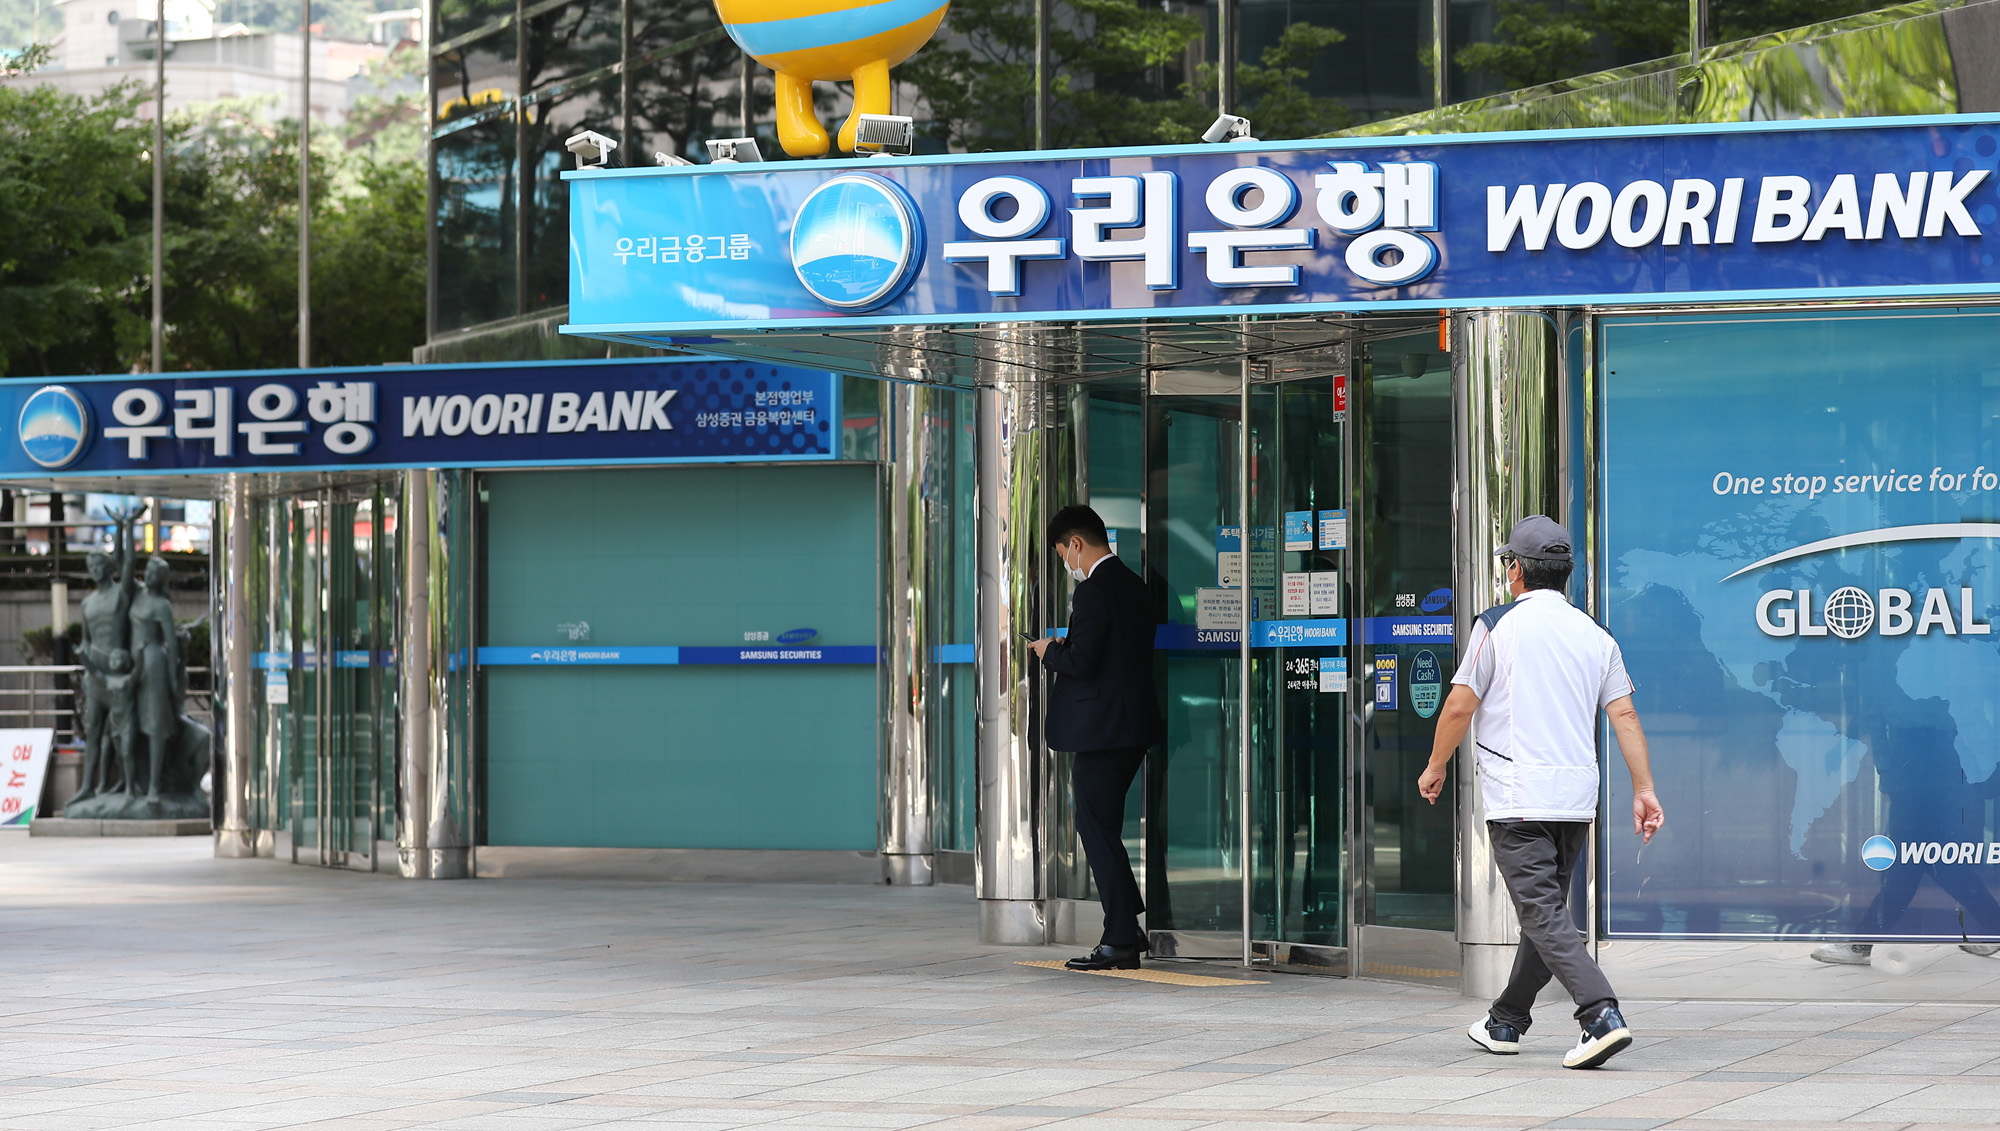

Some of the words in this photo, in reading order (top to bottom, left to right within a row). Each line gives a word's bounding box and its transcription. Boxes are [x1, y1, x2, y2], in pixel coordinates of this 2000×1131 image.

[1486, 177, 1745, 252] WOORI
[1752, 169, 1991, 243] BANK
[943, 160, 1441, 297] 우리은행
[613, 233, 752, 266] 우리금융그룹
[755, 390, 814, 406] 본점영업부
[103, 381, 378, 460] 우리은행
[402, 393, 544, 438] WOORI
[547, 389, 678, 432] BANK
[695, 412, 742, 428] 삼성증권
[744, 410, 815, 426] 금융복합센터
[1713, 471, 1765, 495] One
[1770, 472, 1827, 500] stop
[1832, 468, 1923, 493] service
[1929, 466, 1967, 492] for
[1972, 465, 2000, 491] fo
[1395, 593, 1416, 608] 삼성증권
[1755, 586, 1991, 639] GLOBAL
[1277, 625, 1304, 643] 우리은행
[1304, 627, 1321, 638] WOORI
[1321, 627, 1338, 638] BANK
[1392, 623, 1422, 636] SAMSUNG
[543, 650, 577, 662] 우리은행
[578, 652, 601, 660] WOORI
[601, 652, 620, 660] BANK
[740, 651, 779, 660] SAMSUNG
[779, 650, 822, 660] SECURITIES
[1416, 656, 1433, 669] Need
[1416, 668, 1435, 681] Cash?
[1287, 680, 1301, 690] 24시간
[1302, 680, 1318, 690] 이용가능
[1901, 842, 1984, 865] WOORI
